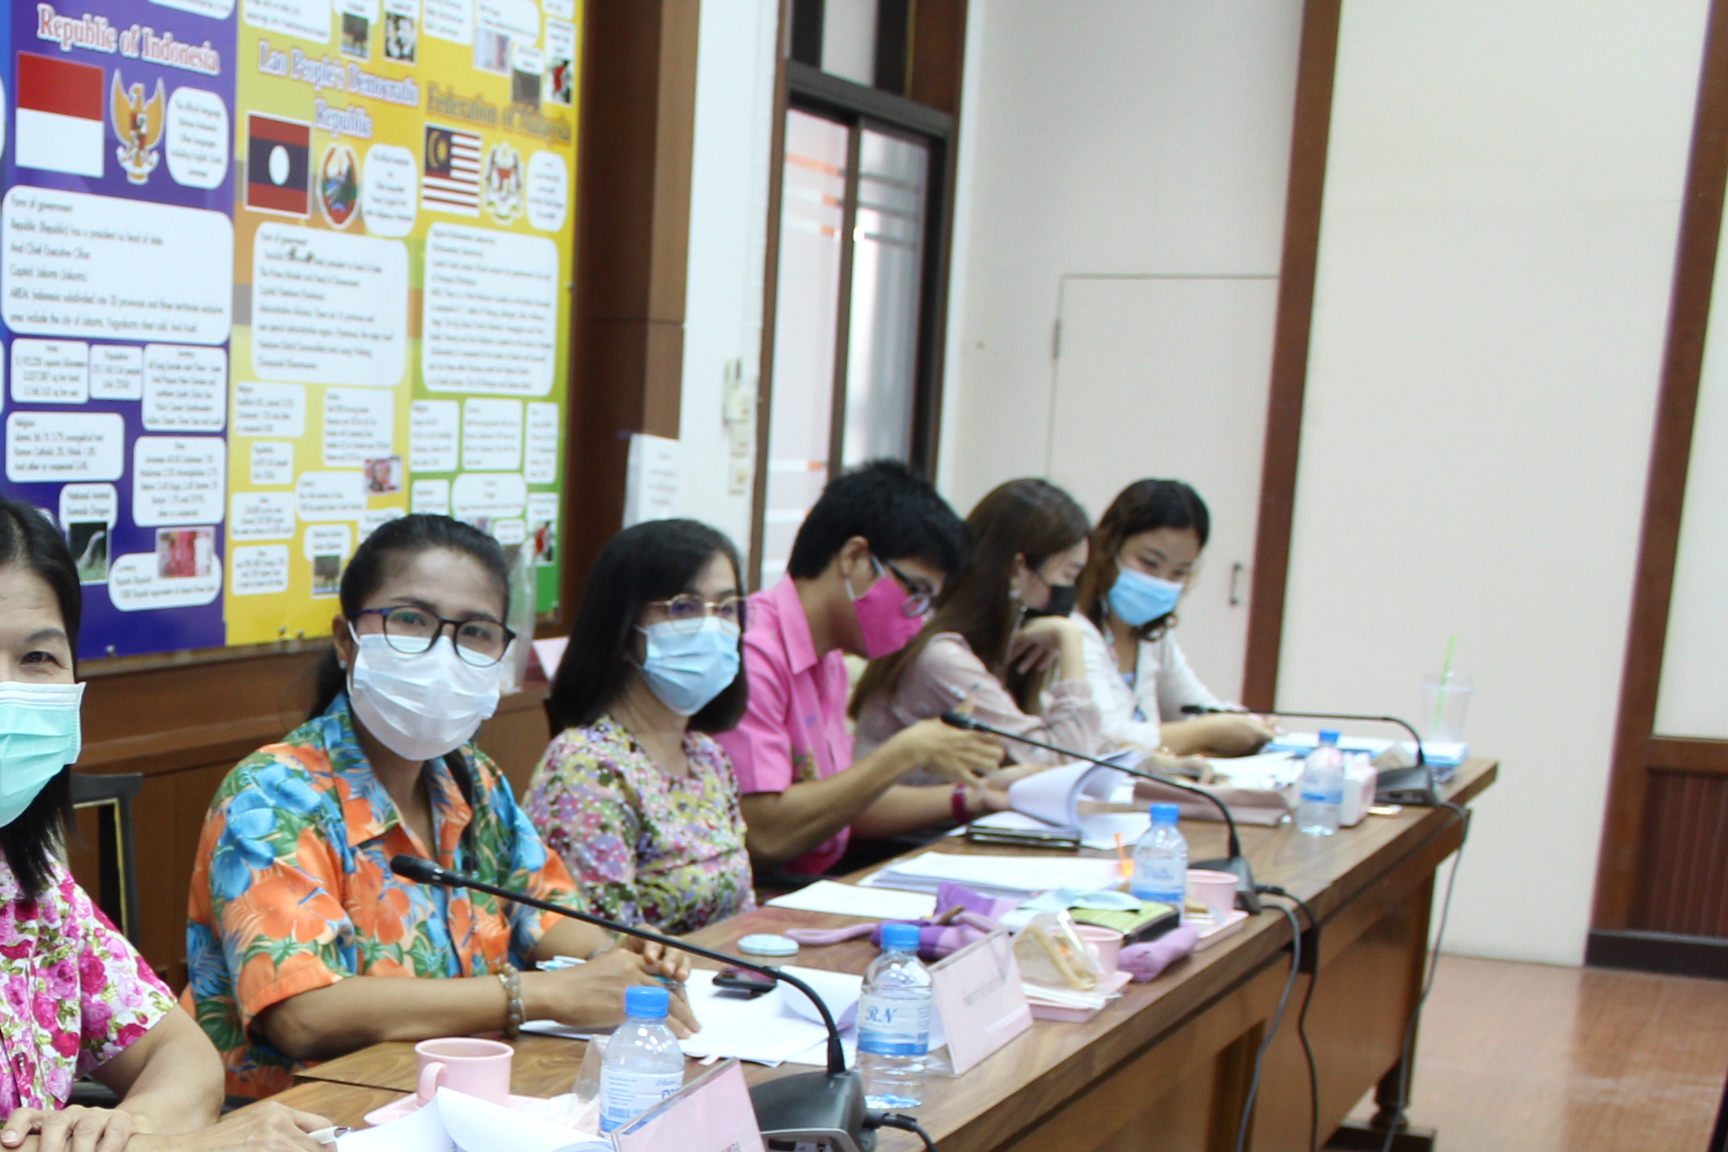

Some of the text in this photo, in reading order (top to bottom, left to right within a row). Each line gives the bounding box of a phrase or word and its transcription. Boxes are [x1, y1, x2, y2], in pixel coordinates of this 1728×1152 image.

[38, 3, 219, 75] Republic of Indonesia
